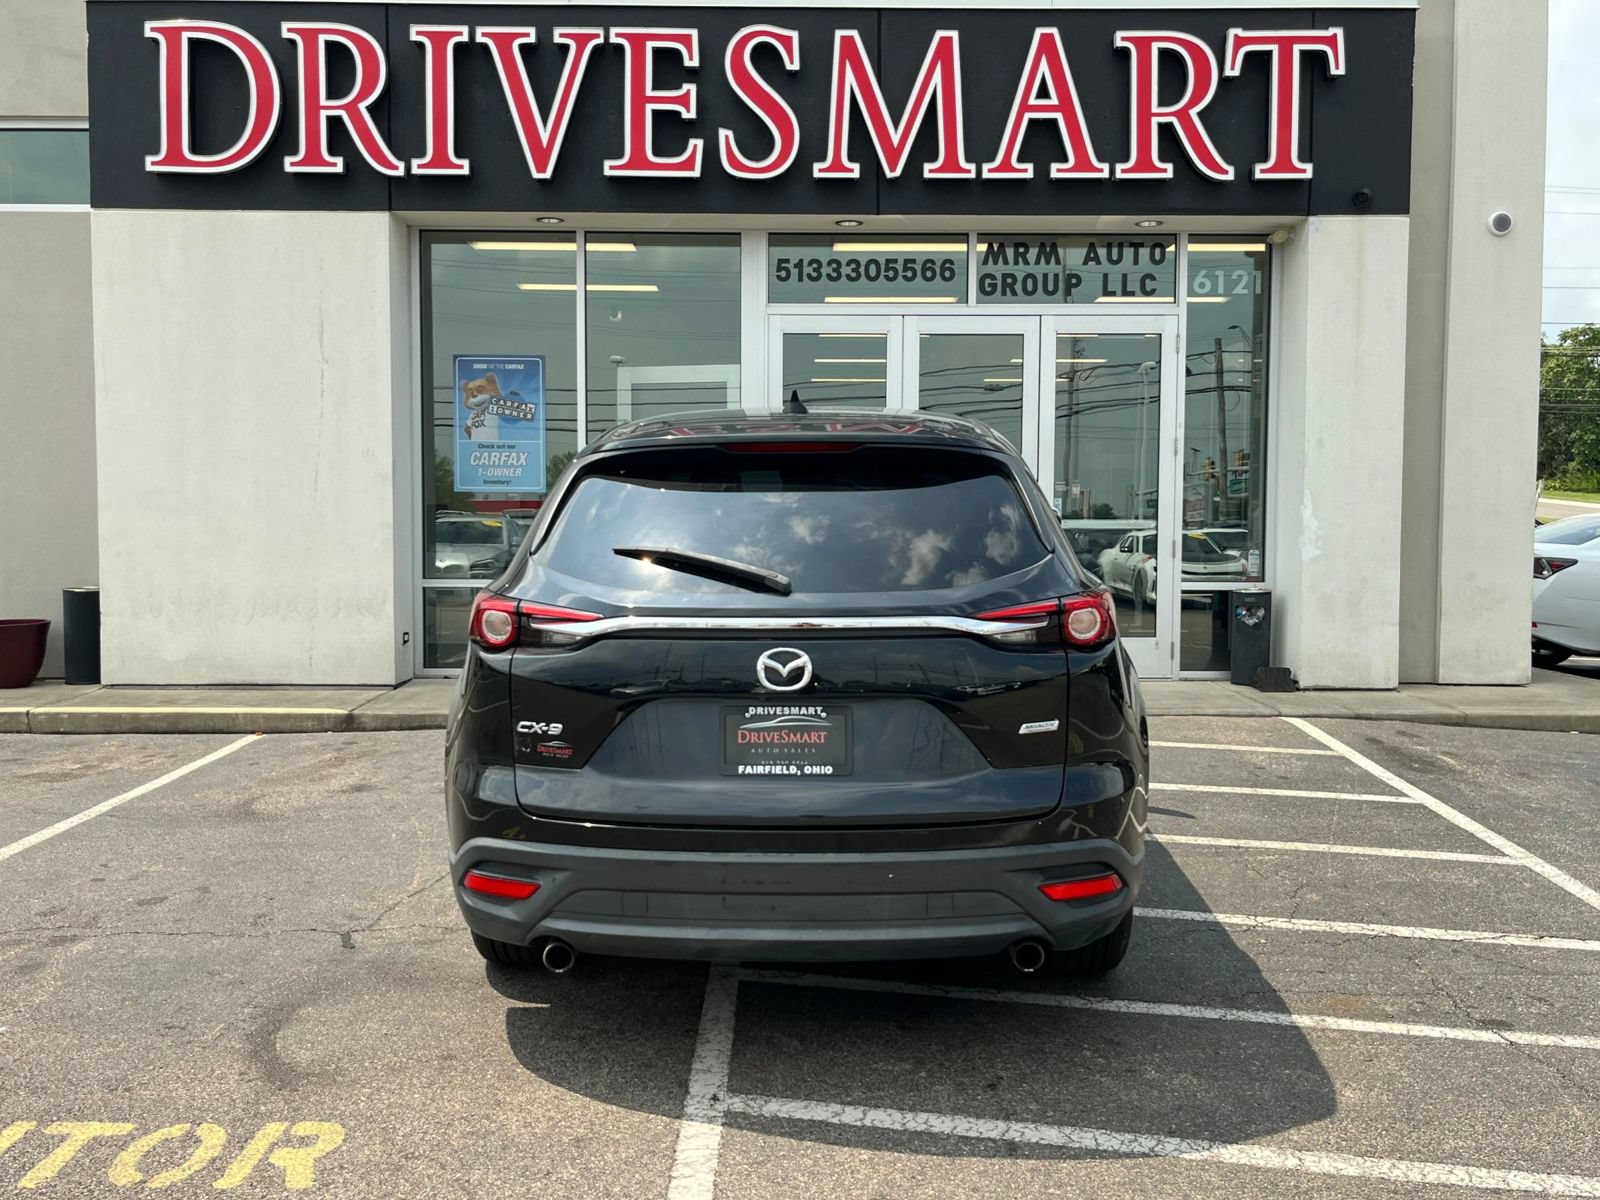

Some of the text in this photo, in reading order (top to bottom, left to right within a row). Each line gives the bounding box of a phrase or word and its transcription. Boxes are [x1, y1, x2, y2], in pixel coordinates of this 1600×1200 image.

[143, 19, 1348, 182] DRIVESMART
[982, 241, 1167, 266] MRM AUTO
[775, 258, 956, 283] 5133305566
[978, 272, 1158, 297] GROUP LLC
[1192, 269, 1262, 295] 6121
[470, 452, 529, 466] CARFAX
[477, 467, 522, 477] 1-OWNER
[748, 706, 824, 716] DRIVESMART
[516, 720, 564, 735] CX-9
[738, 765, 833, 776] FAIRFIELD, OHIO
